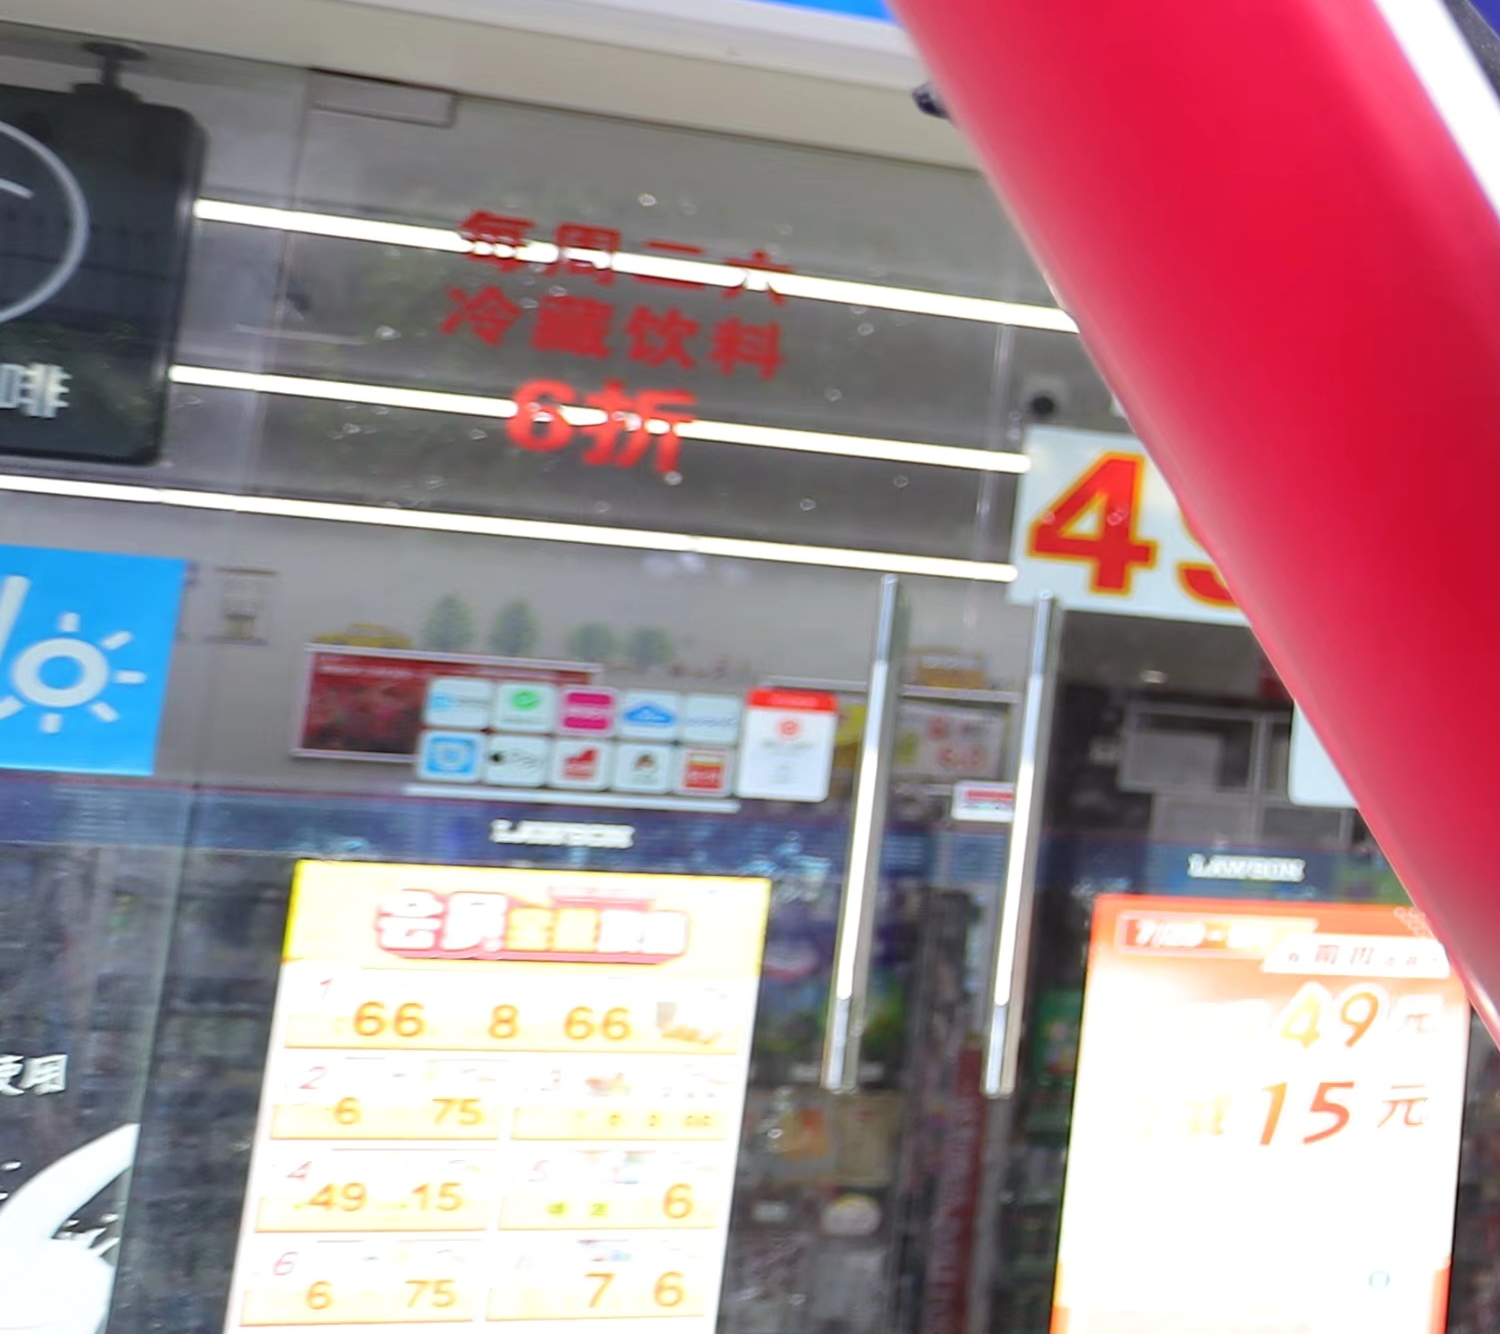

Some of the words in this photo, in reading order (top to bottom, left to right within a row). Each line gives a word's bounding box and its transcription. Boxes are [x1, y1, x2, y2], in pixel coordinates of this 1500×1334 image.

[440, 284, 786, 381] 冷藏饮料
[505, 377, 698, 473] 6折
[353, 1000, 427, 1038] 66
[487, 1003, 520, 1040] 8
[562, 1005, 633, 1041] 66
[332, 1096, 362, 1126] 6
[431, 1098, 484, 1126] 75
[308, 1181, 368, 1212] 49
[410, 1181, 464, 1212] 15
[662, 1182, 695, 1220] 6
[305, 1280, 334, 1310] 6
[403, 1279, 457, 1308] 75
[583, 1272, 616, 1308] 7
[653, 1271, 686, 1307] 6
